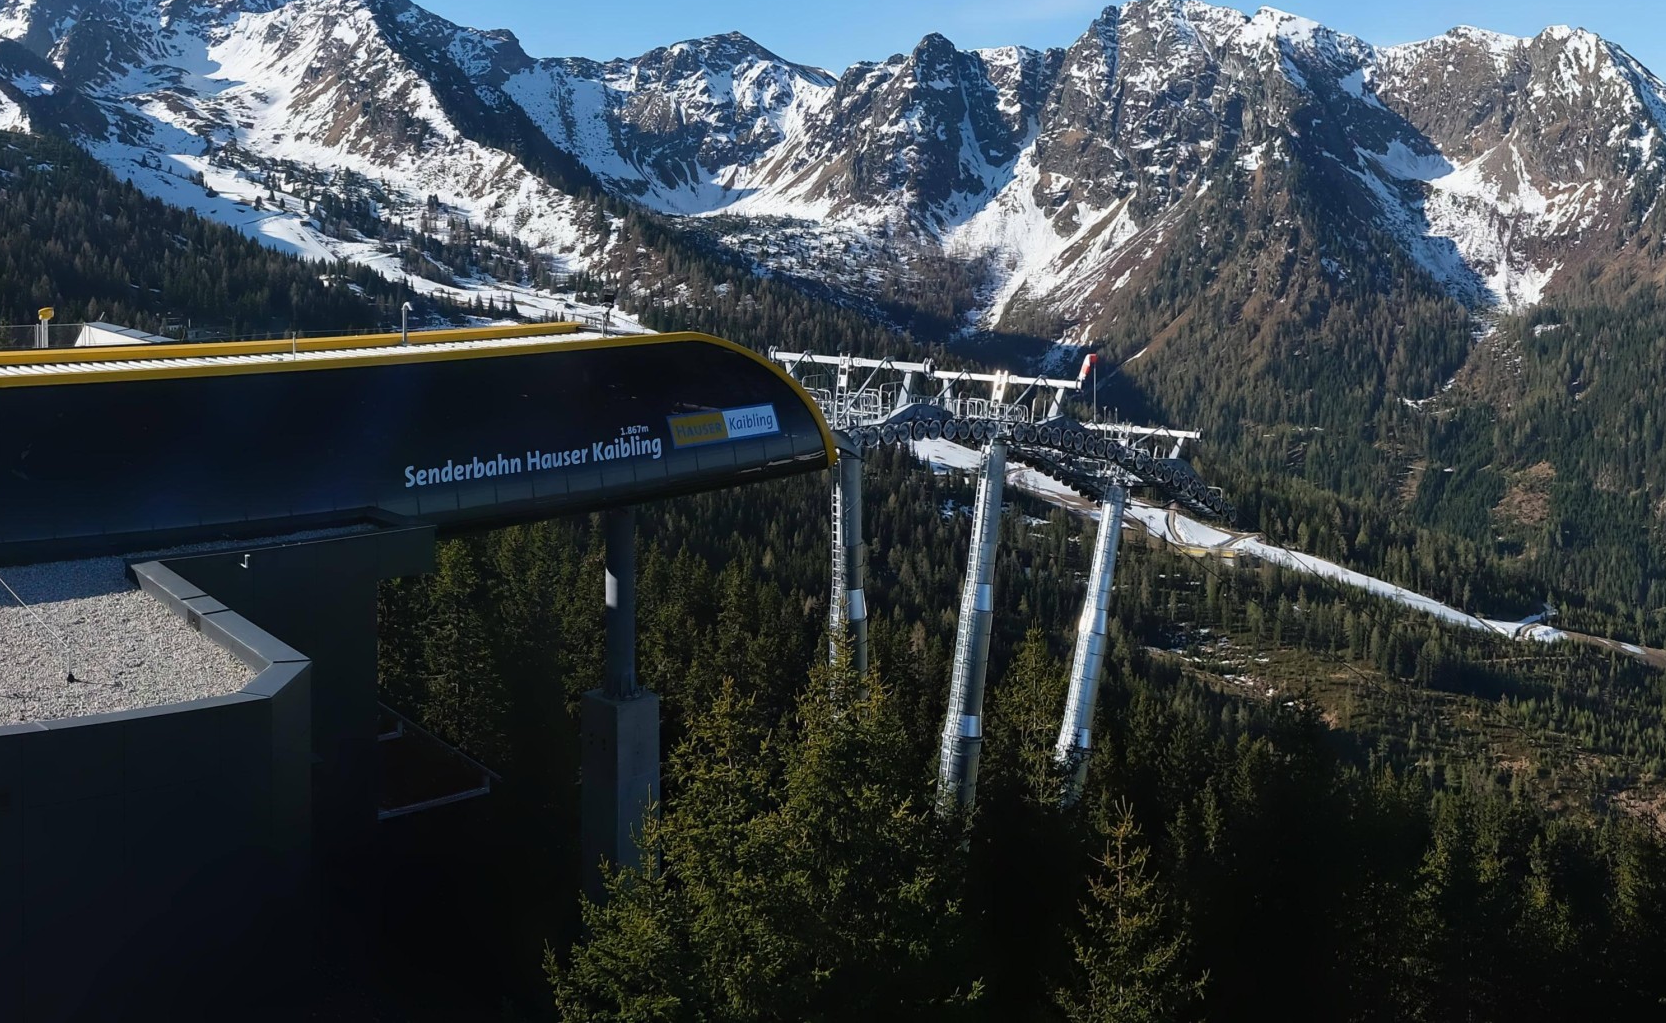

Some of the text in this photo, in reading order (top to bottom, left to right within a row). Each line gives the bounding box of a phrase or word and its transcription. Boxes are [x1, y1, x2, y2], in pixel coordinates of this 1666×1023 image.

[728, 414, 773, 431] Kaibling
[404, 436, 662, 488] Senderbahn Hauser Kaibling
